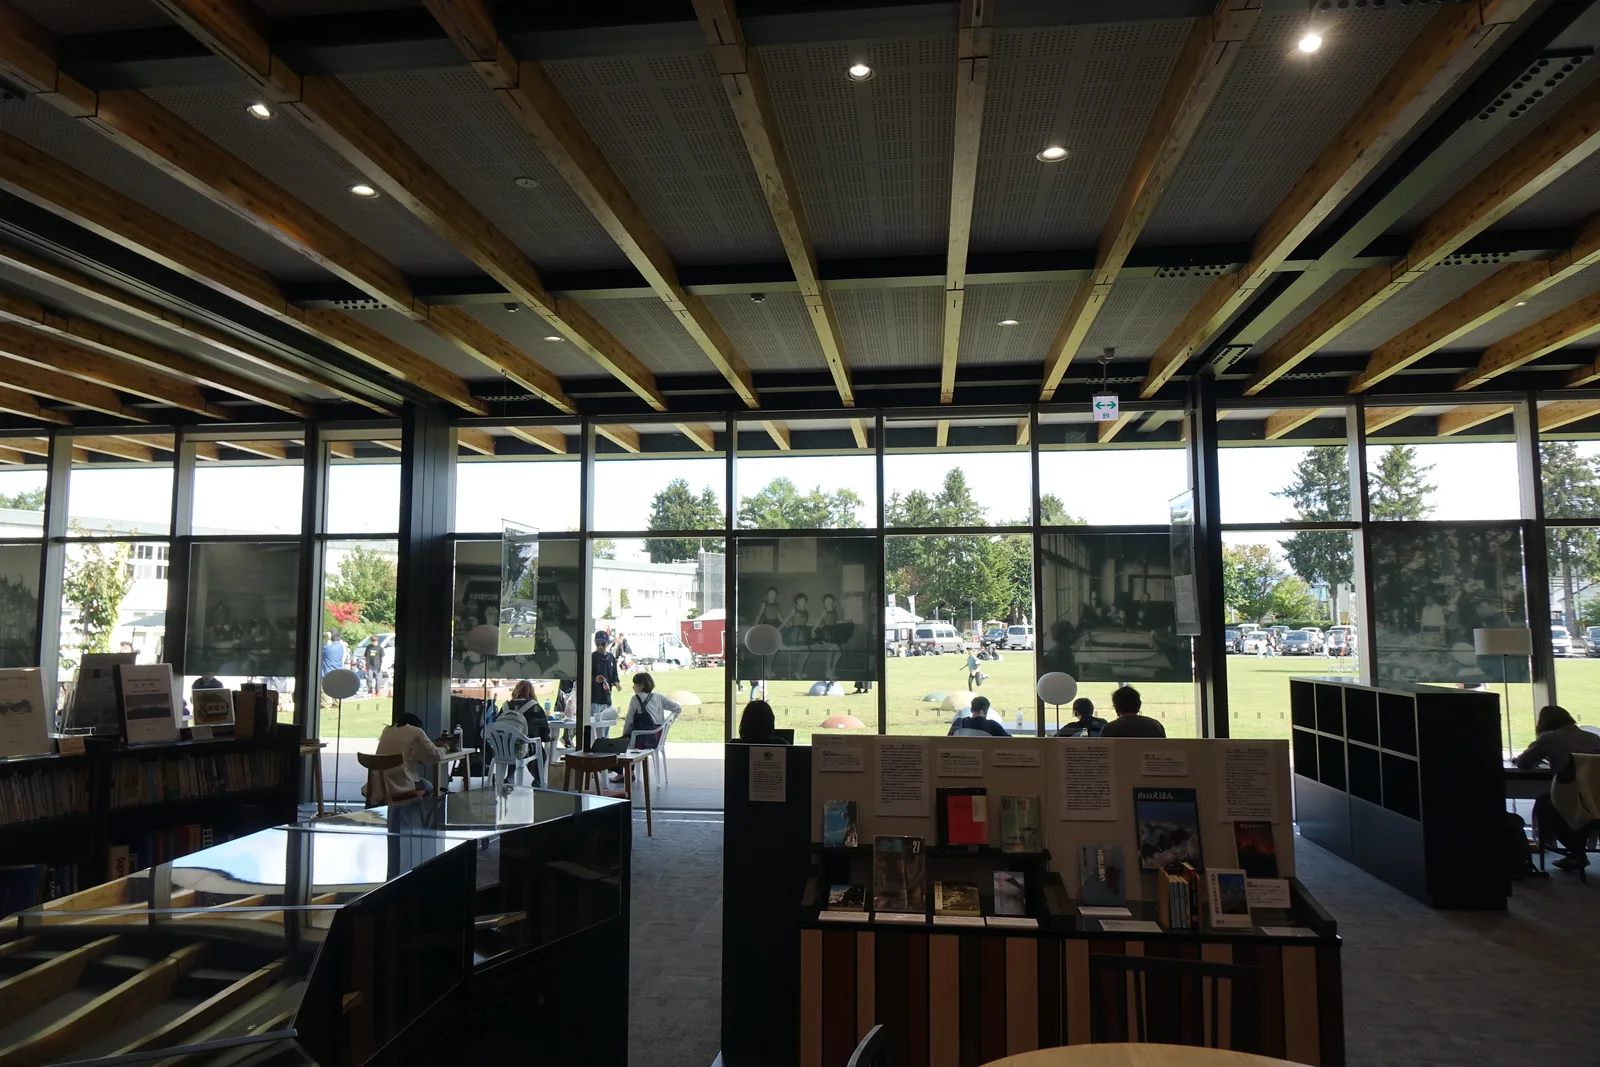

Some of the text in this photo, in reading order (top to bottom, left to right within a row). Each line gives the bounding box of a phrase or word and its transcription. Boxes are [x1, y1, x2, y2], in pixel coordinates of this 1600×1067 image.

[1137, 791, 1174, 800] 山のえほん
[912, 840, 921, 853] 27
